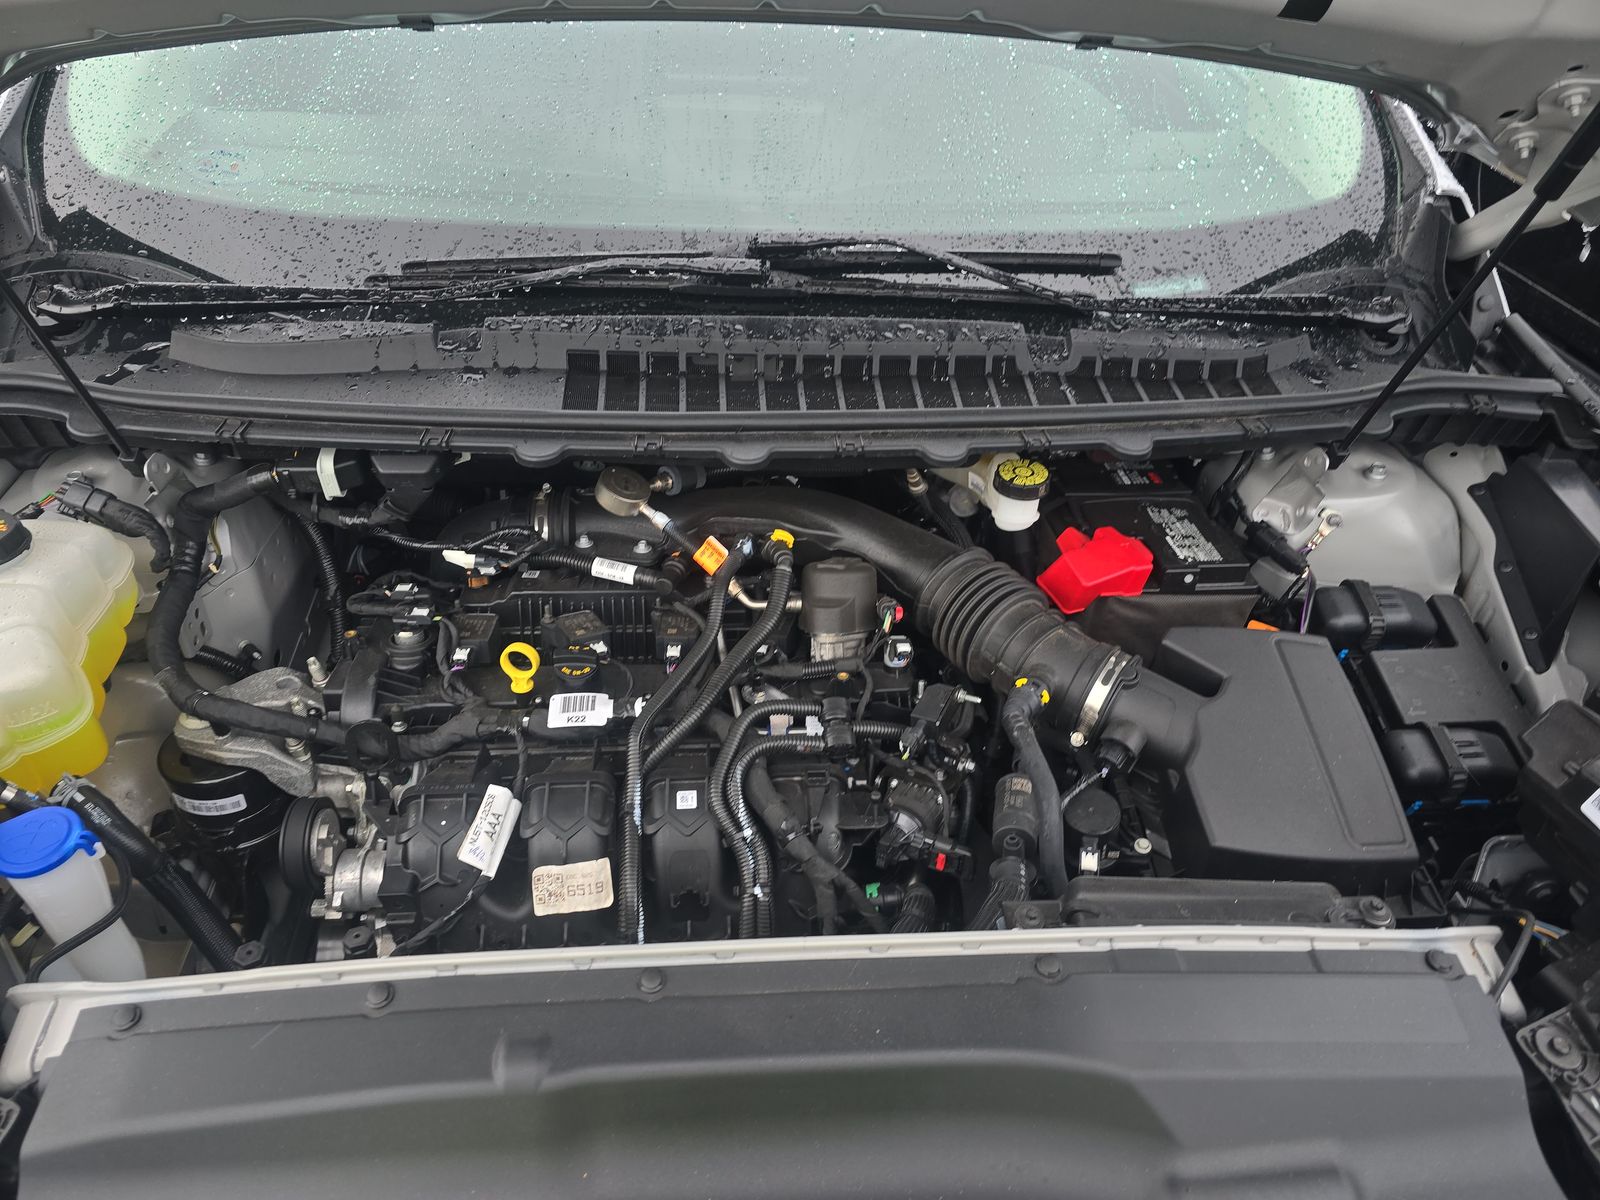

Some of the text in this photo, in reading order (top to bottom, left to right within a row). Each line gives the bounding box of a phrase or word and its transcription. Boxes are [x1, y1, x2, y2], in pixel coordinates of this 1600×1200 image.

[566, 715, 587, 724] K22
[484, 812, 503, 842] AAA
[566, 880, 604, 897] 6519
